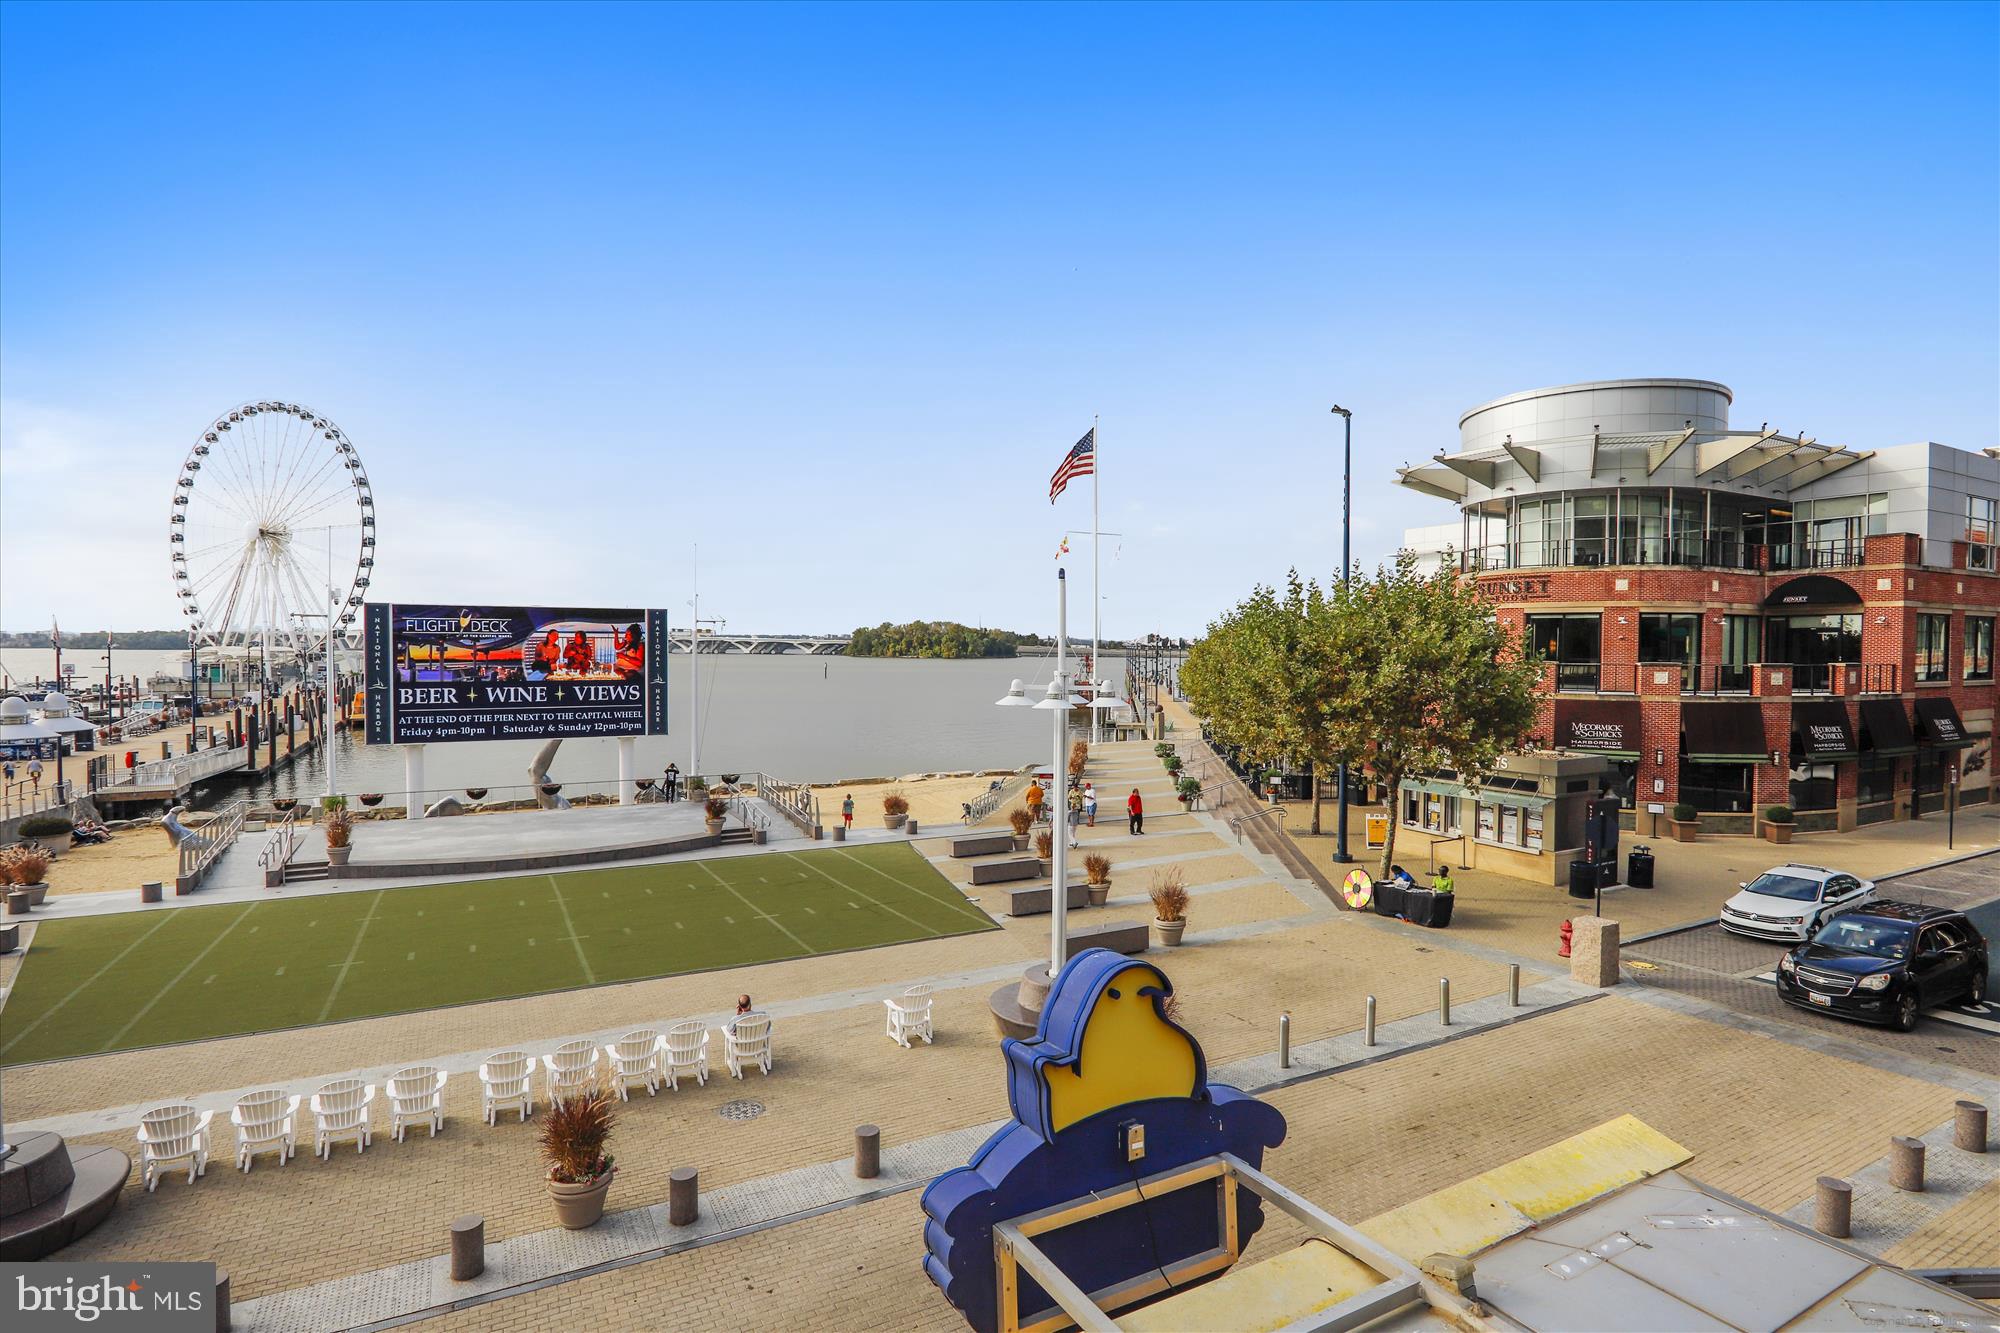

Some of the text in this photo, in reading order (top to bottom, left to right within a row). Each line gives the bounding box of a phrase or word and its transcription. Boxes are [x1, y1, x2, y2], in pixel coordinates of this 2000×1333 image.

[1478, 579, 1550, 595] SUNSET
[406, 619, 508, 632] FLIGHT DECK
[399, 685, 640, 704] BEER WINE VIEWS
[399, 716, 413, 724] AT
[414, 715, 434, 723] THE
[436, 715, 456, 723] END
[473, 714, 493, 722] THE
[494, 714, 514, 722] PIER
[516, 713, 540, 721] NEXT
[556, 712, 574, 720] THE
[613, 711, 643, 719] WHEEL
[401, 728, 433, 738] Friday
[436, 726, 485, 736] 4pm-10pm
[503, 724, 544, 734] Saturday
[558, 723, 592, 732] Sunday
[594, 722, 642, 732] 12pm-10pm
